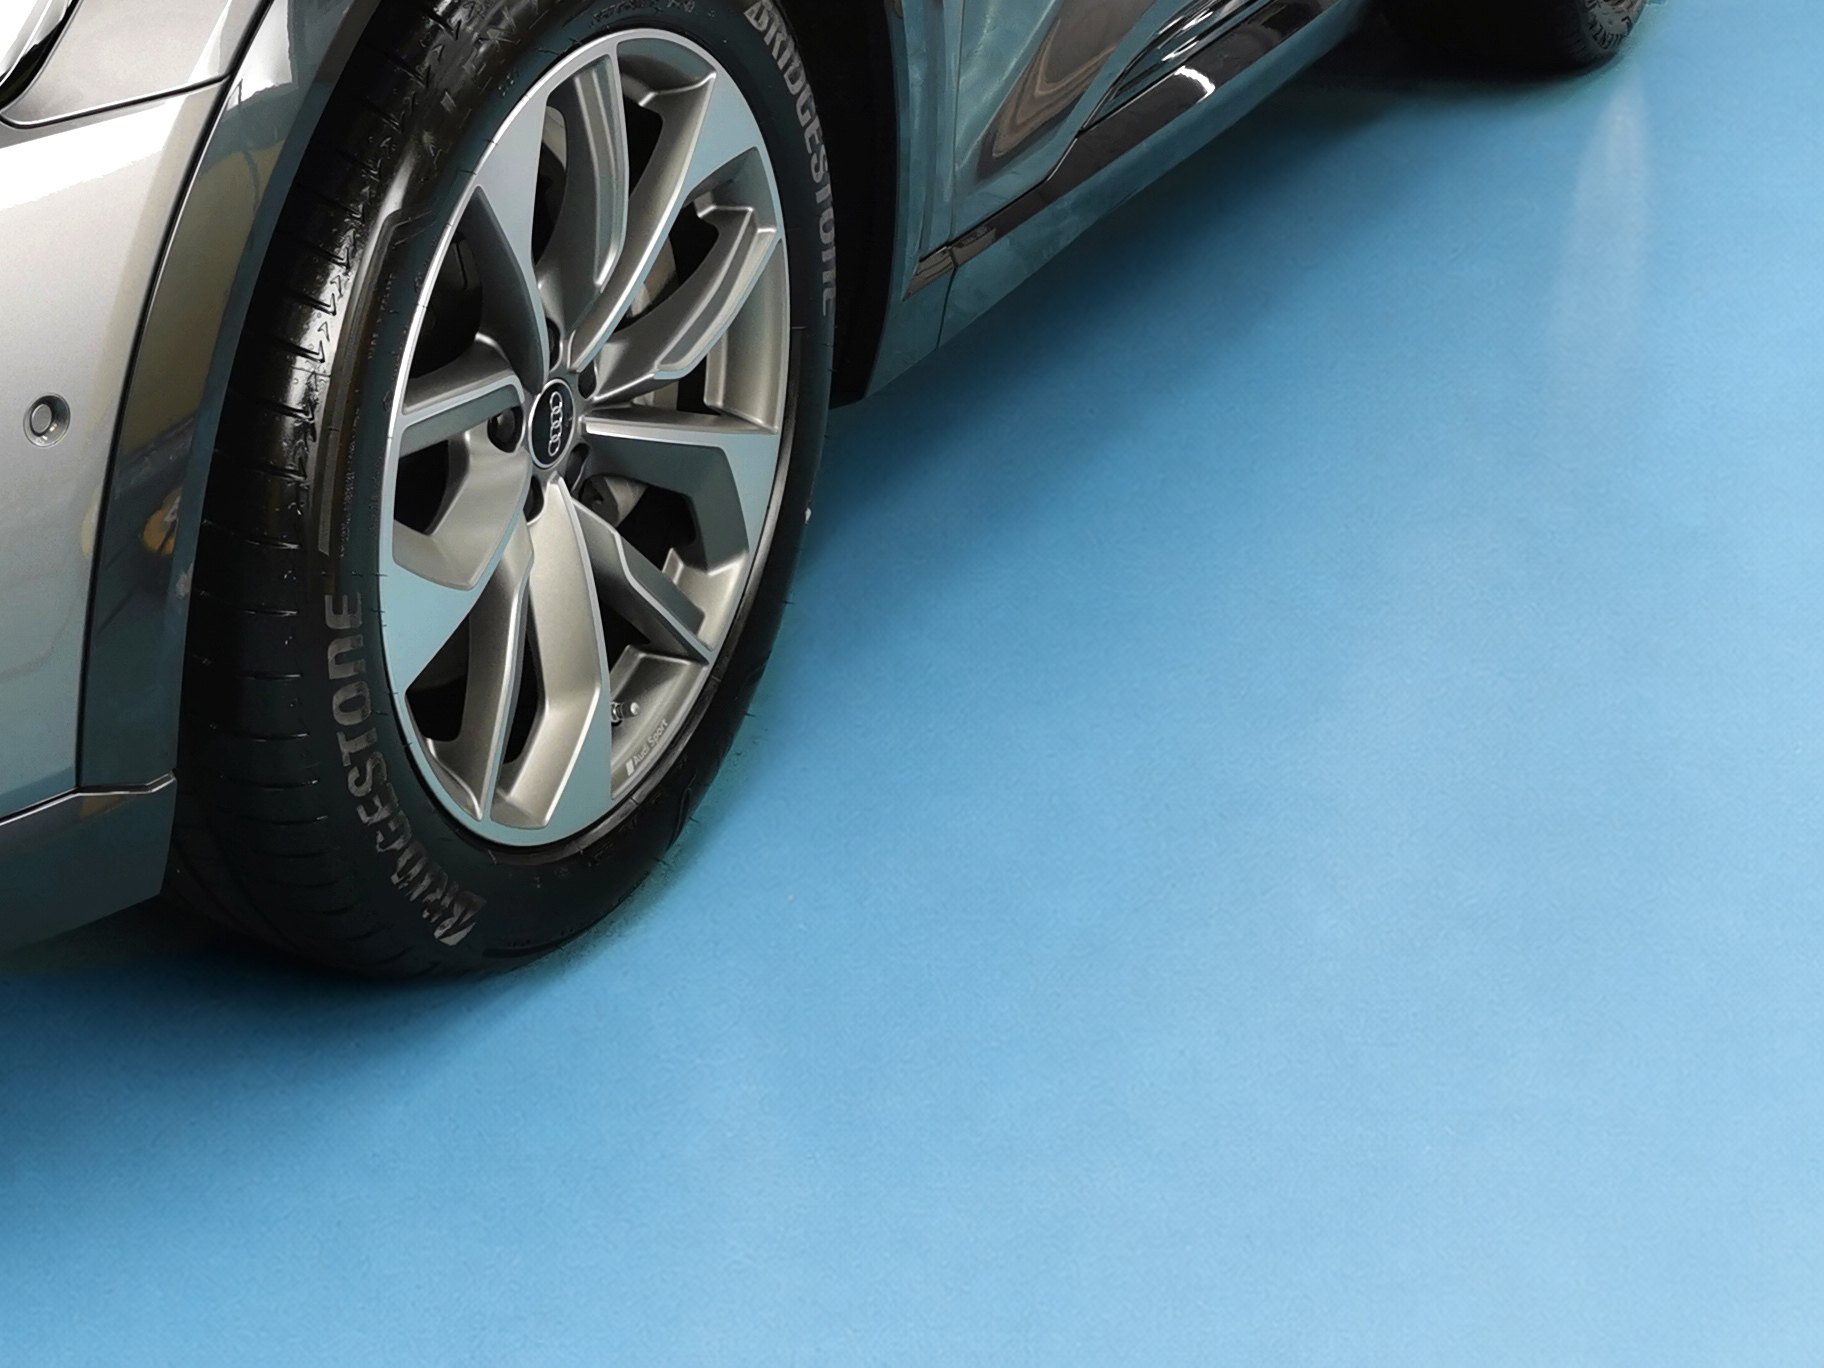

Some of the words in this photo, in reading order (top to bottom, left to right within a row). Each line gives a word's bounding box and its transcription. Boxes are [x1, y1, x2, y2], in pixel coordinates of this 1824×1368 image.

[324, 591, 488, 946] BRIDGESTONE
[633, 744, 650, 766] Audi
[647, 719, 668, 747] Sport
